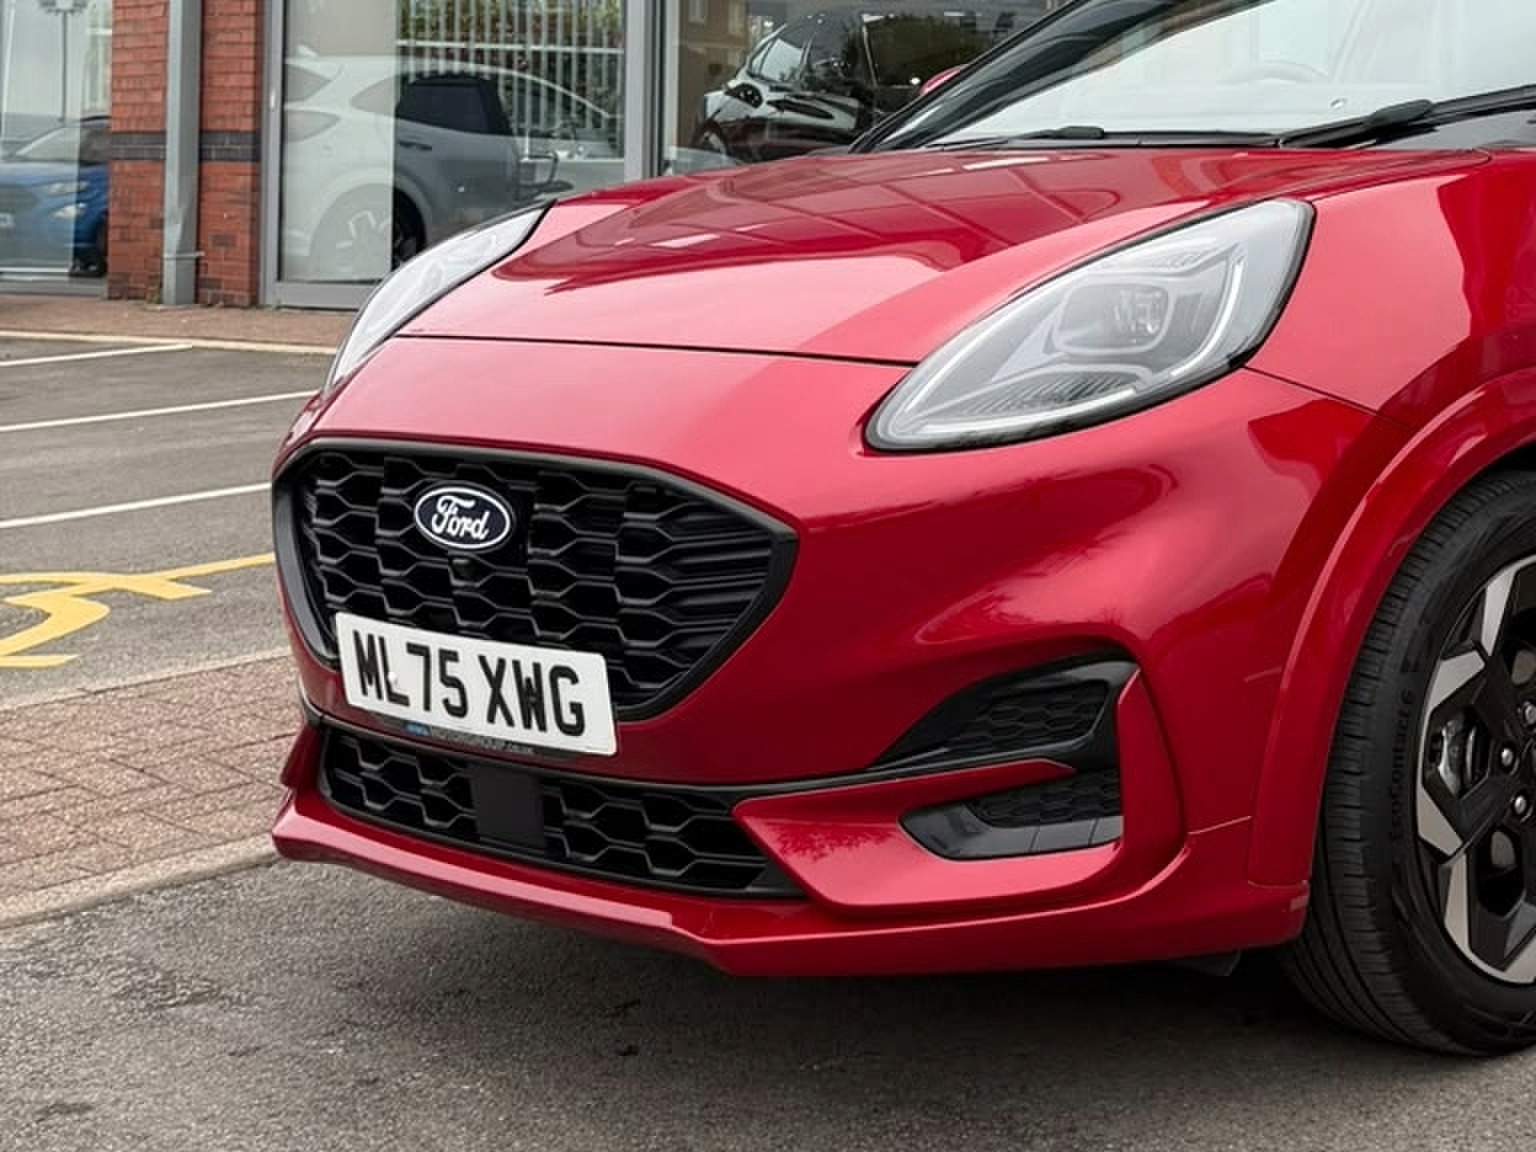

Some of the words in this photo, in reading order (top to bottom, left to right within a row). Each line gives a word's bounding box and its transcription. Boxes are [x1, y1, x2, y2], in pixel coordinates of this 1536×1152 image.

[431, 496, 489, 539] Ford
[353, 630, 469, 719] ML75
[478, 655, 585, 737] XWG
